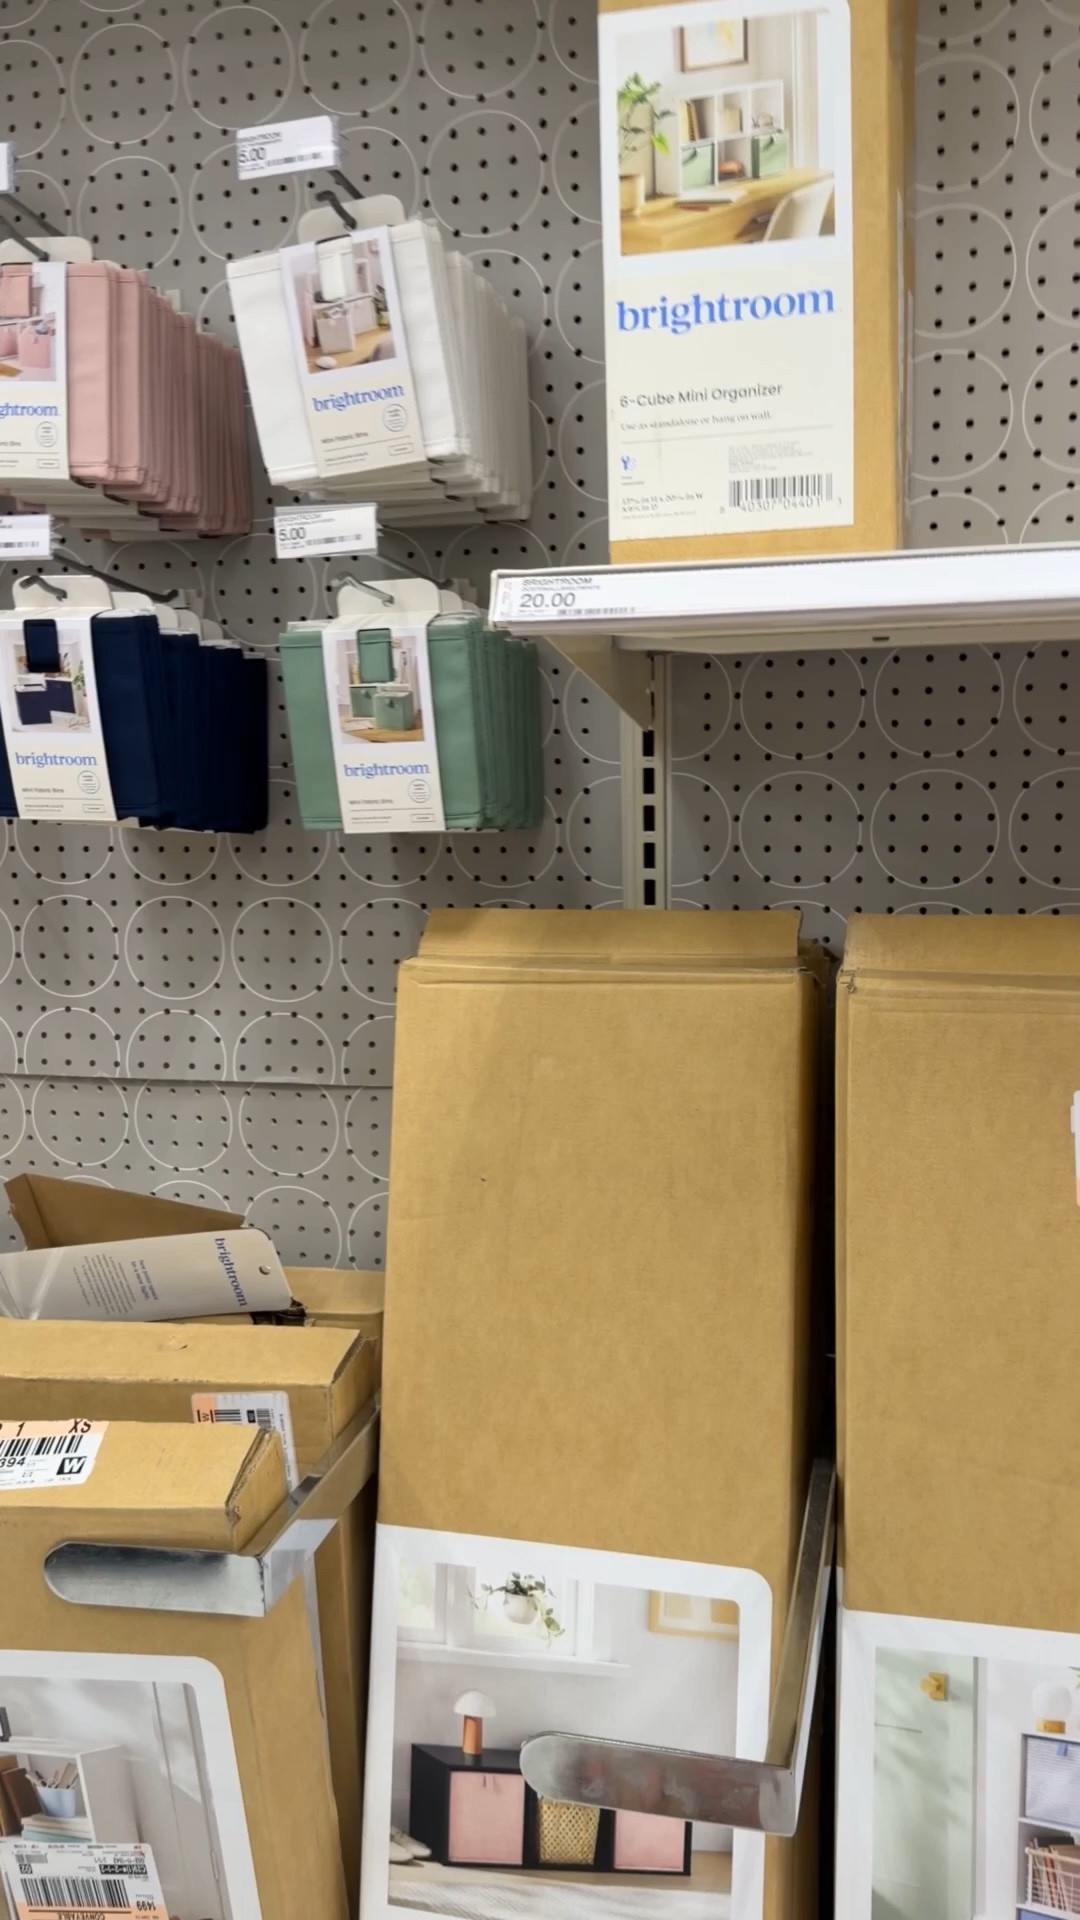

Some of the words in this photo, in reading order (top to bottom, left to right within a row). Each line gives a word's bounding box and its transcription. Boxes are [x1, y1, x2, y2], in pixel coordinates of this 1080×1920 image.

[239, 147, 267, 164] 5.00
[616, 288, 835, 336] brightroom
[312, 385, 404, 412] brightroom
[620, 391, 675, 408] 6-Cube
[679, 388, 708, 404] Mini
[711, 382, 783, 403] Organizer
[712, 413, 735, 425] hang
[737, 414, 748, 423] on
[279, 526, 306, 542] 5.00
[519, 592, 576, 608] 20.00
[15, 752, 98, 768] brightroom
[343, 763, 431, 779] brightroom
[214, 1237, 248, 1307] brightroom
[16, 1422, 26, 1437] 1
[68, 1418, 92, 1434] XS
[136, 1901, 156, 1911] 1499
